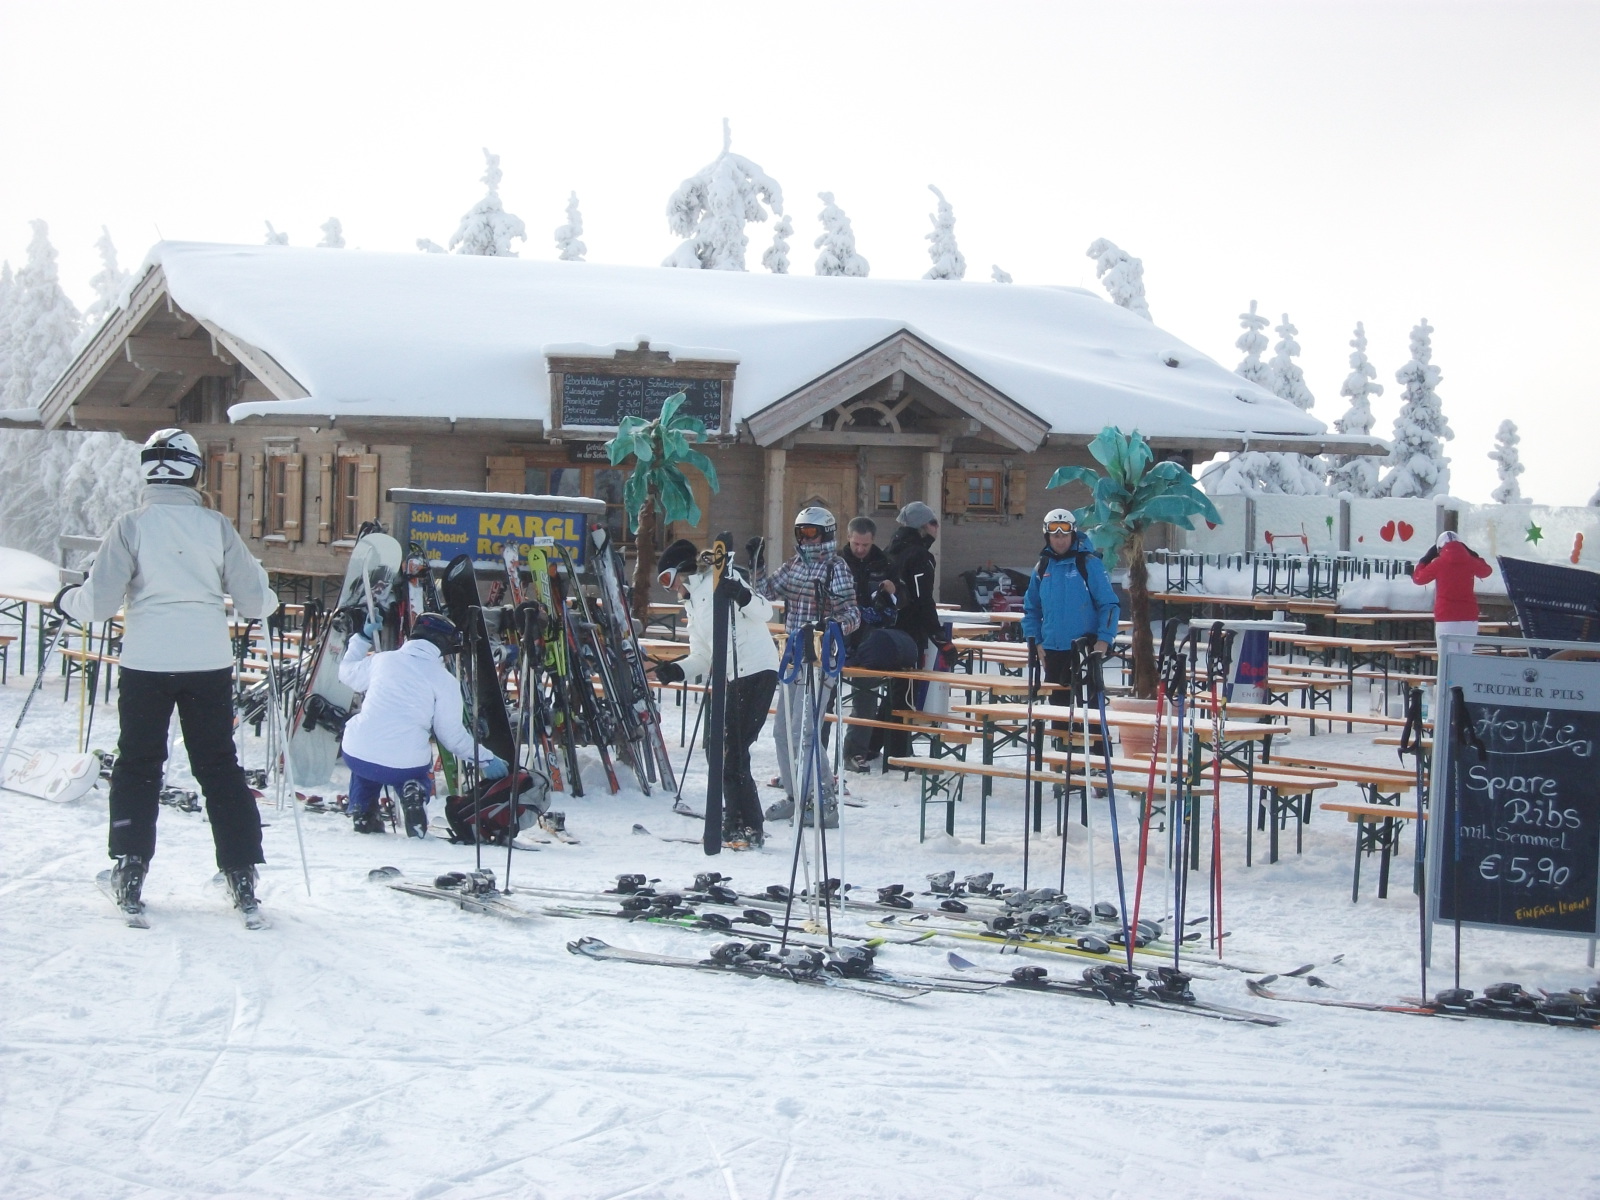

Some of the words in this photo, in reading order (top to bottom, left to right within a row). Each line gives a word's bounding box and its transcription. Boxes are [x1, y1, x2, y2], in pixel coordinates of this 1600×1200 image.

[411, 510, 434, 523] Schi-
[437, 513, 457, 525] und
[478, 513, 580, 541] KARGL
[410, 529, 469, 544] Snowboard-
[1473, 683, 1544, 698] TRUMER
[1550, 688, 1584, 700] PILS
[1475, 707, 1575, 746] Heute
[1466, 765, 1558, 800] Spare
[1503, 798, 1581, 829] Ribs
[1496, 826, 1571, 851] Semmel
[1479, 853, 1502, 880] €
[1506, 857, 1570, 888] 5,90
